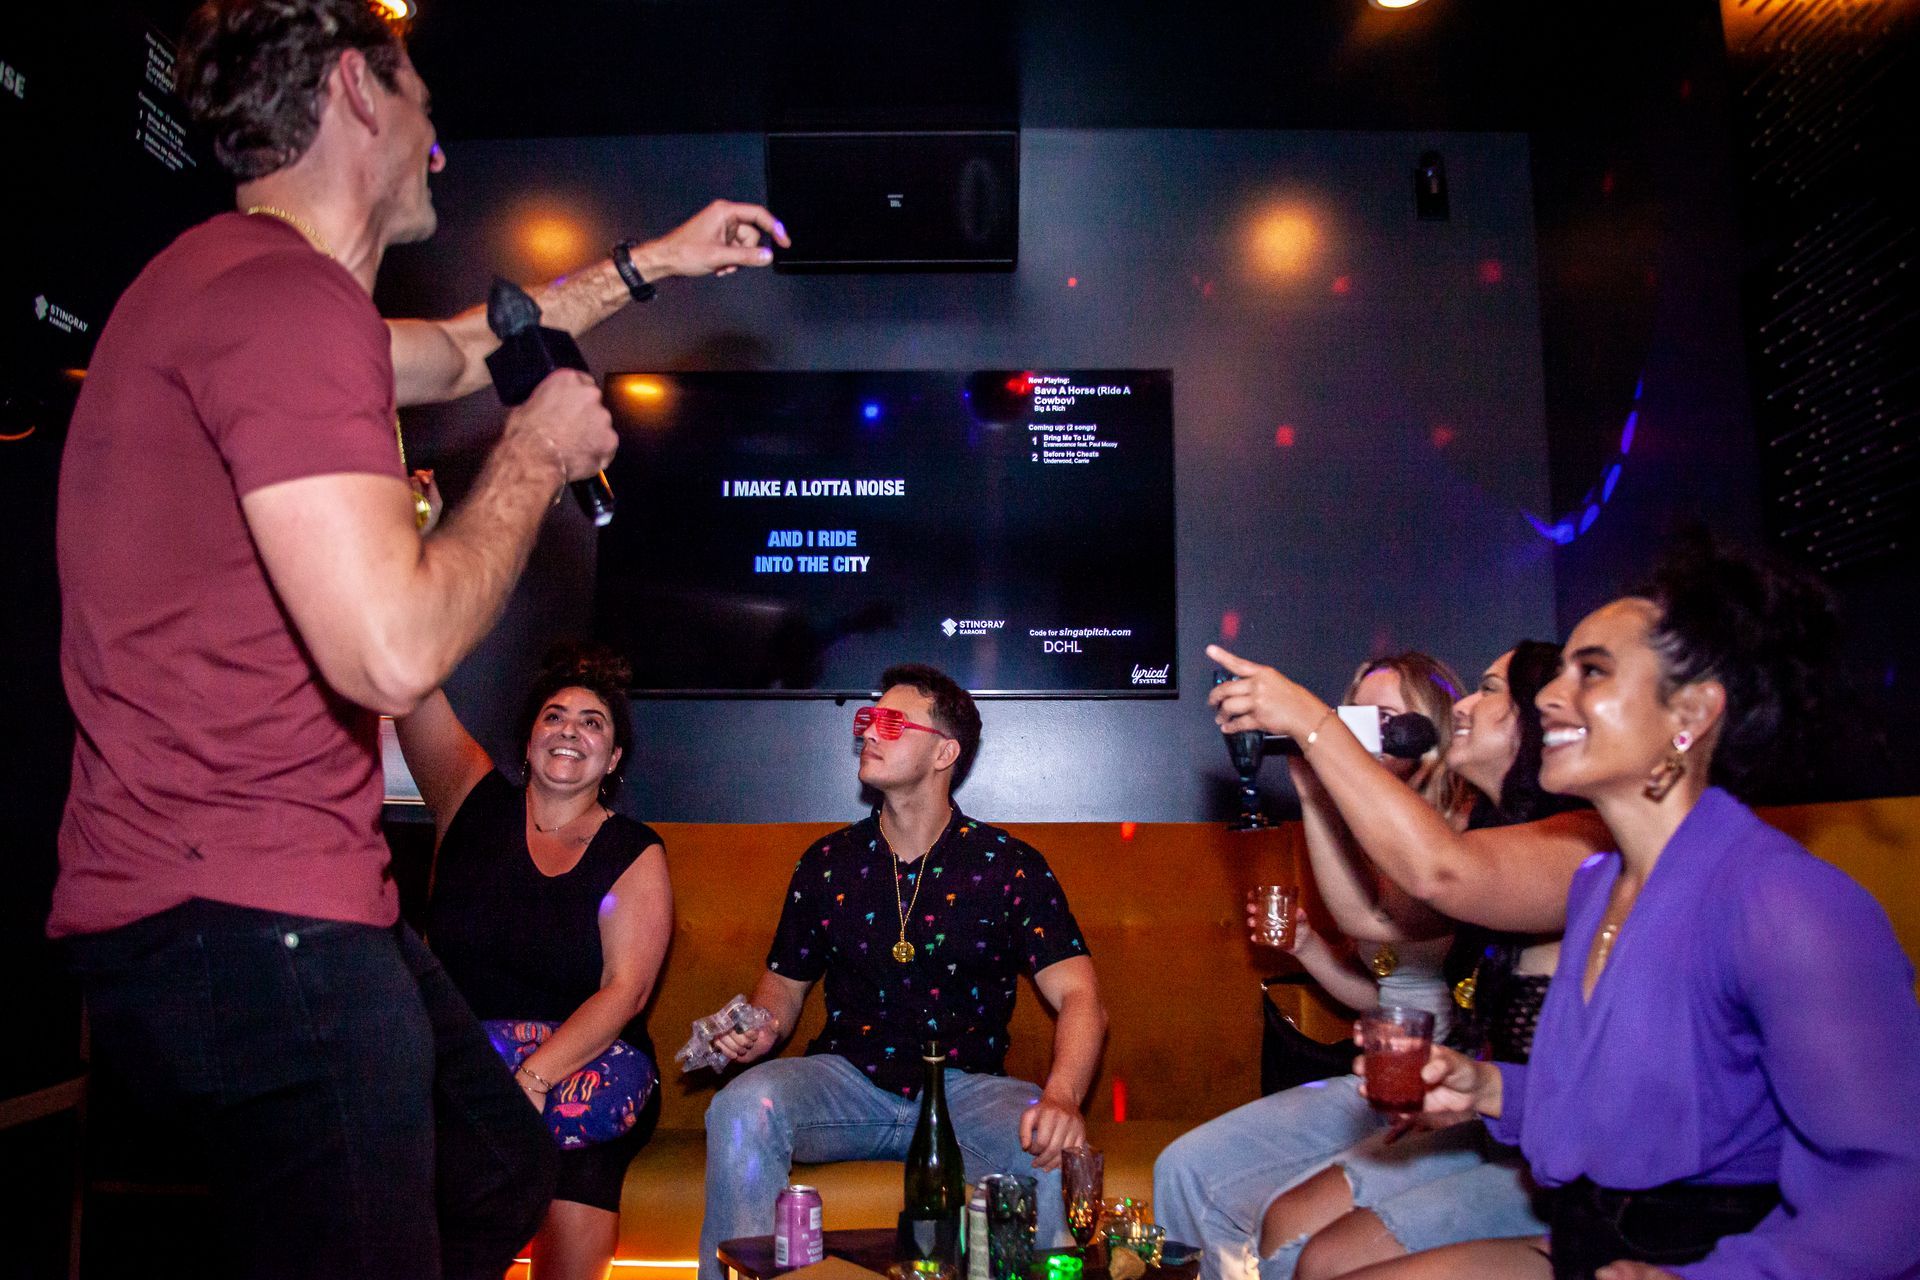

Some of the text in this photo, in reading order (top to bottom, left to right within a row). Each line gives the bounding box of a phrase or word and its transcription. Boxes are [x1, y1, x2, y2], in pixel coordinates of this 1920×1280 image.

[50, 304, 88, 332] STINGRAY
[1044, 377, 1070, 385] Playing:
[1034, 386, 1131, 396] Save A Horse (Ride A
[1028, 424, 1053, 432] Coming
[1066, 424, 1073, 432] (2
[1074, 424, 1097, 432] songs)
[1032, 437, 1037, 446] 1
[1043, 434, 1061, 442] Bring
[1032, 450, 1099, 462] 2 Before He Cheats
[723, 480, 905, 496] I MAKE A LOTTA NOISE
[768, 530, 857, 547] AND I RIDE
[755, 556, 870, 572] INTO THE CITY
[959, 620, 1005, 629] STINGRAY
[1059, 628, 1131, 638] singatpitch.com
[1043, 641, 1082, 653] DCHL
[1131, 664, 1169, 684] lyrical
